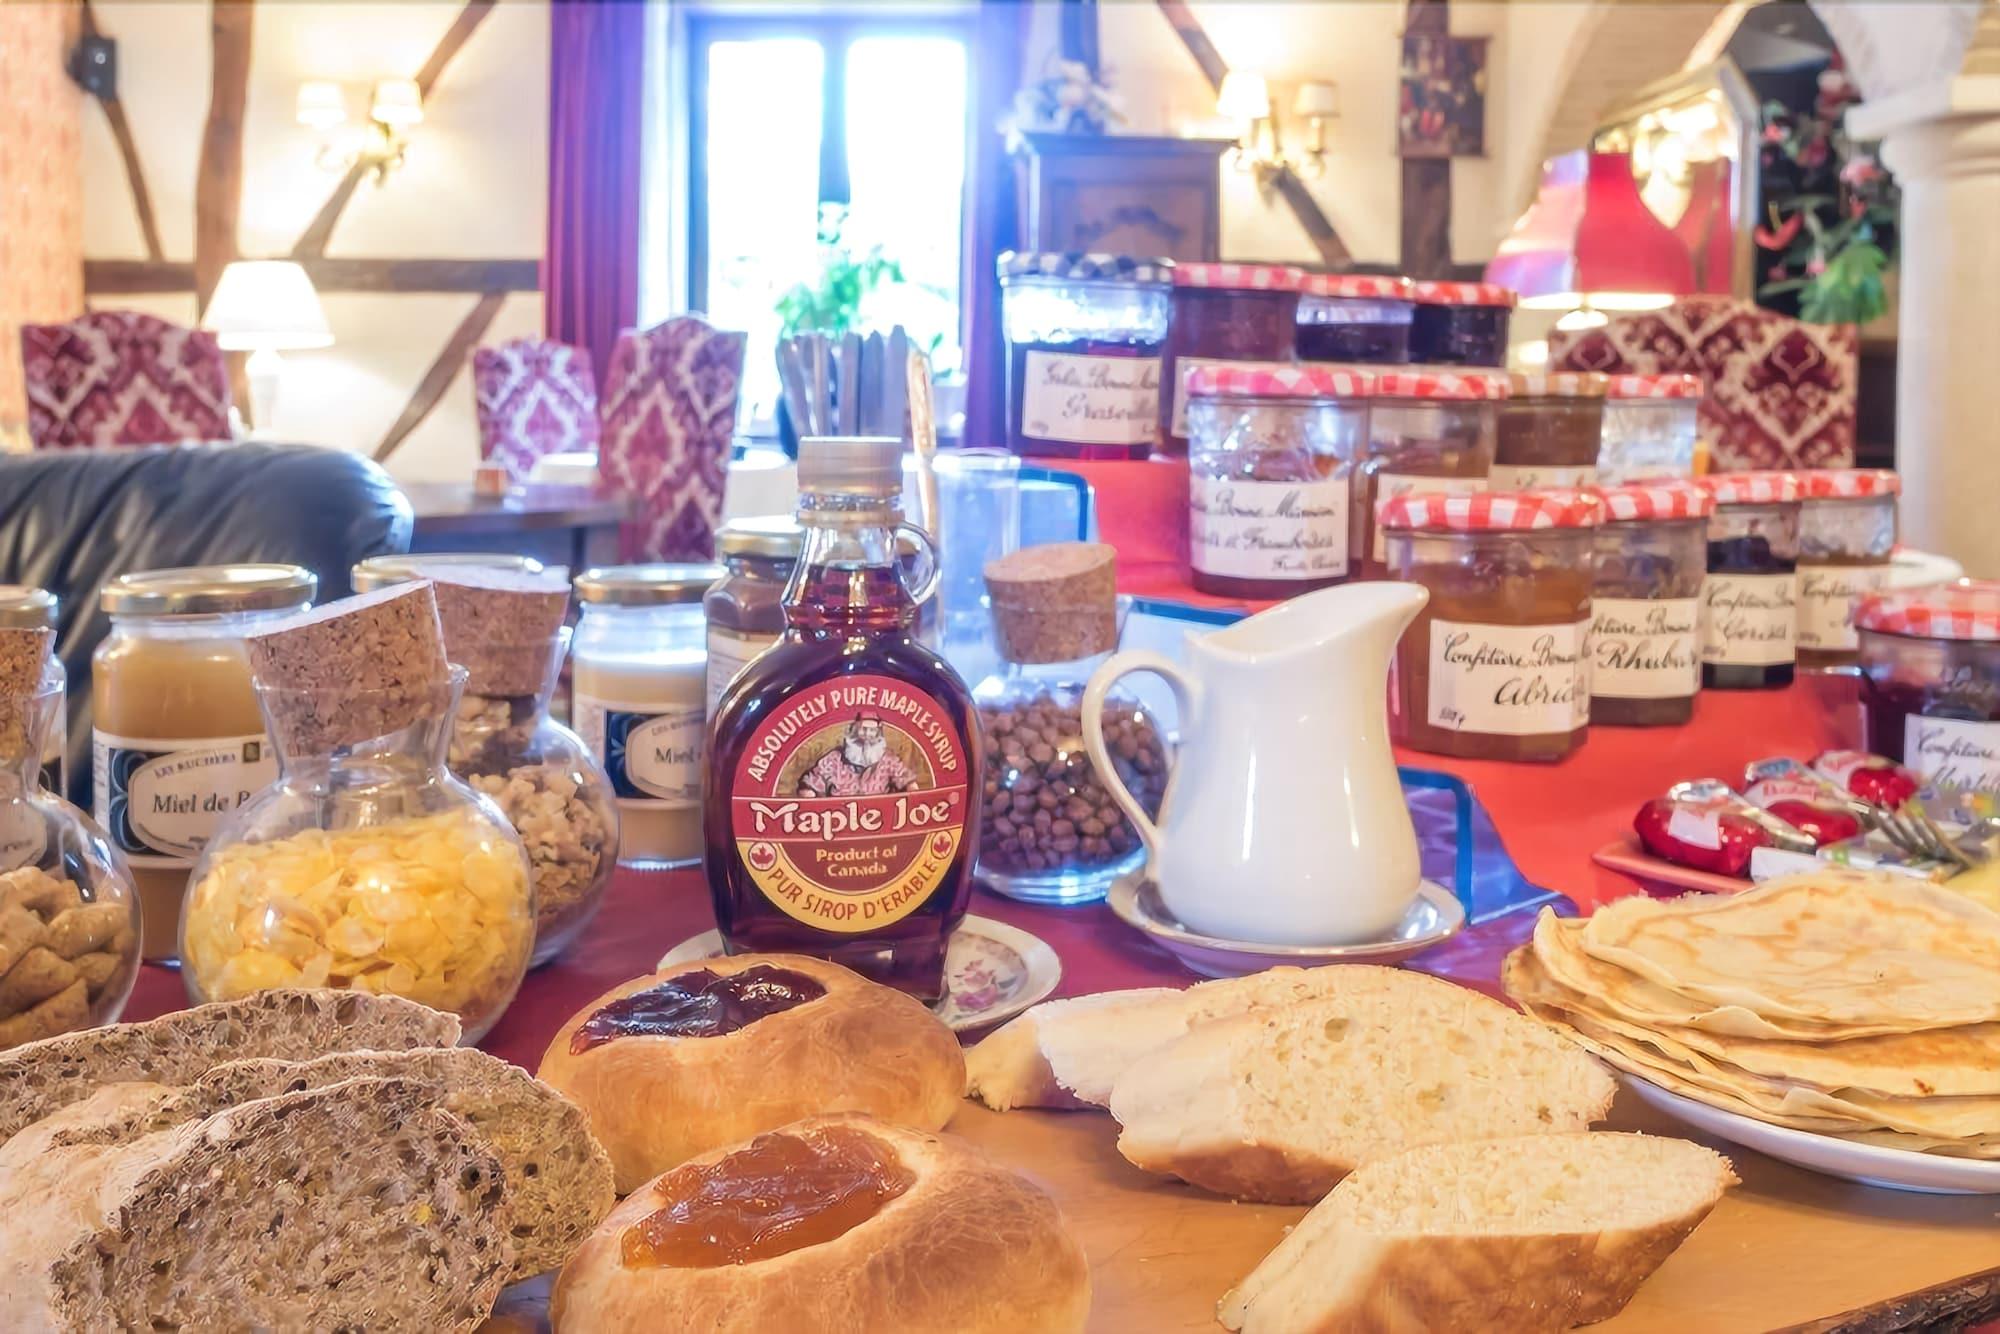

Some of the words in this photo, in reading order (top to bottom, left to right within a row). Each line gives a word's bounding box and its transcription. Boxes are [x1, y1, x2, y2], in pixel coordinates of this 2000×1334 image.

[1444, 632, 1524, 672] Confiture
[747, 694, 828, 782] ABSOLUTELY
[830, 686, 877, 709] PURE
[878, 688, 932, 730] MAPLE
[924, 721, 957, 770] SYRUP
[153, 793, 197, 814] Miel
[202, 792, 230, 813] de
[750, 801, 882, 841] Maple
[892, 798, 949, 831] Joe
[816, 846, 878, 862] Product
[882, 844, 898, 858] of
[827, 862, 888, 877] Canada
[767, 867, 803, 904] PUR
[801, 893, 858, 920] SIROP
